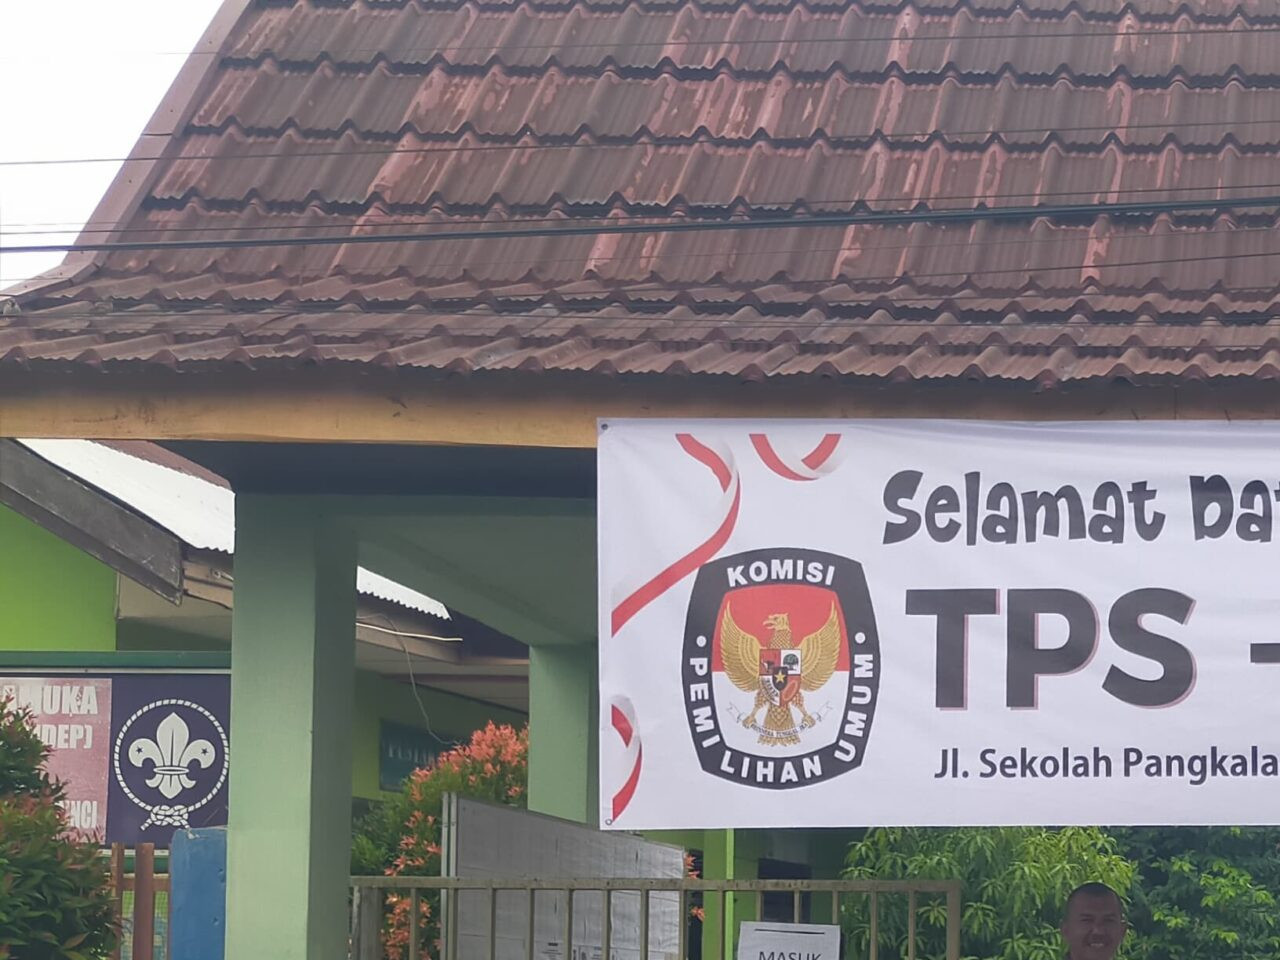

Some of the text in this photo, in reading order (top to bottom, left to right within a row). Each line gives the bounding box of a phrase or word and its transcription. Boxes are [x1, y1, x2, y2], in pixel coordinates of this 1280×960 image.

[882, 469, 1166, 546] Selamat
[727, 559, 835, 587] KOMISI
[905, 587, 1198, 710] TPS
[834, 654, 873, 762] UMUM
[933, 747, 970, 779] Jl.
[979, 747, 1113, 779] Sekolah
